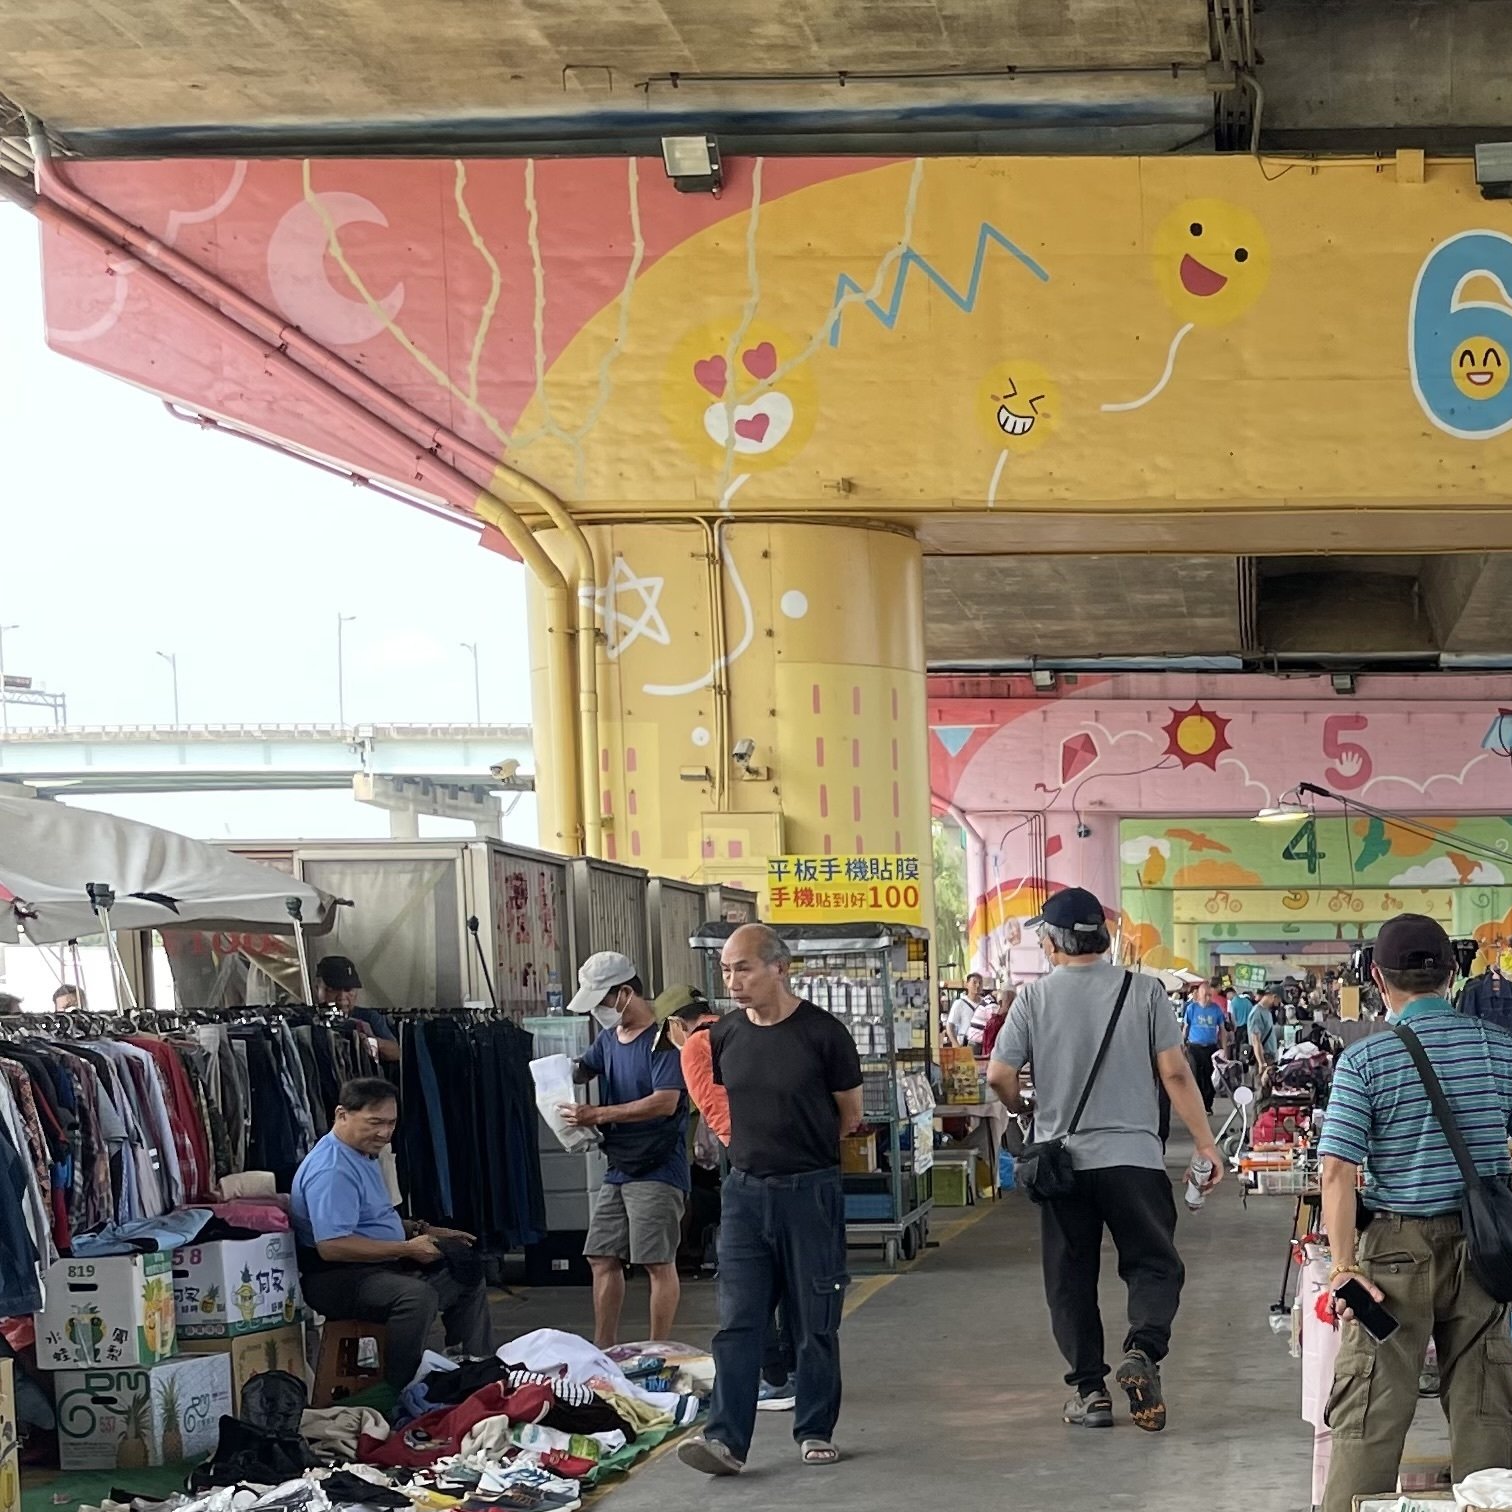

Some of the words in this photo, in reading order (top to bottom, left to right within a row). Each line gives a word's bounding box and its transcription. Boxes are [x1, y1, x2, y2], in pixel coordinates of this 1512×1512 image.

[1323, 715, 1372, 790] 5
[1282, 820, 1326, 874] 4
[768, 858, 919, 882] 平板手機貼膜
[67, 1265, 95, 1278] 819
